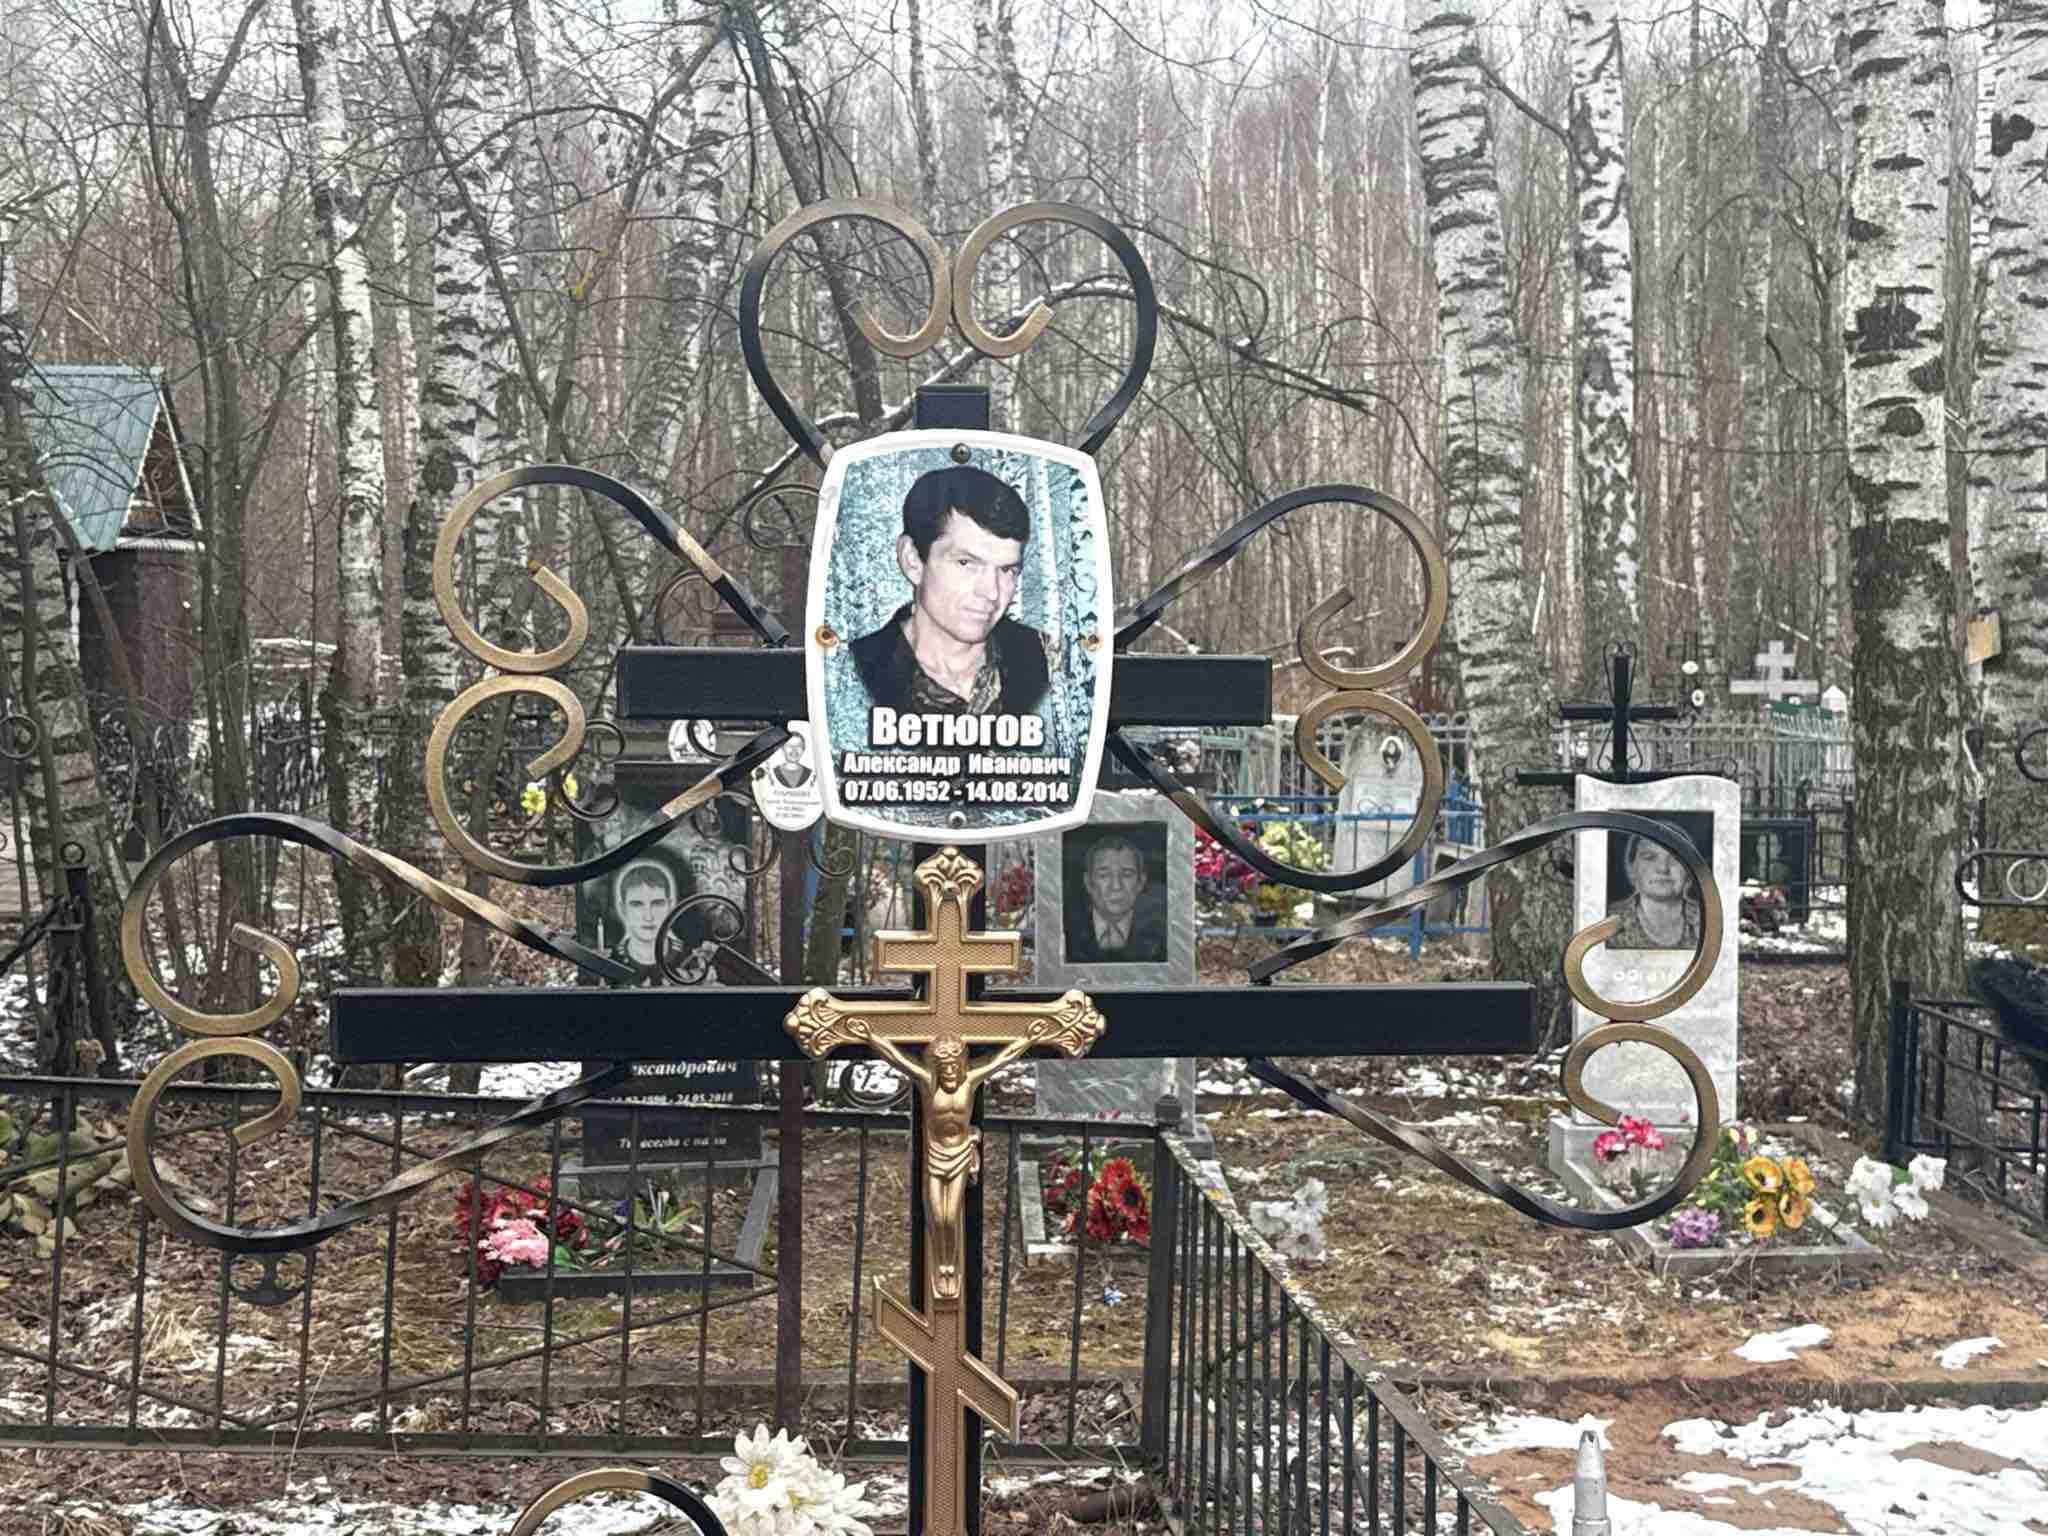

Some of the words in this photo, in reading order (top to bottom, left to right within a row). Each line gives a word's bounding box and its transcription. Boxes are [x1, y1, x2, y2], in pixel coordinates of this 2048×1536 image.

[872, 706, 1044, 747] Ветюгов
[843, 753, 961, 776] Александр
[968, 753, 1071, 775] Иванович
[844, 780, 950, 802] 07.06.1952
[965, 781, 1069, 802] 14.08.2014
